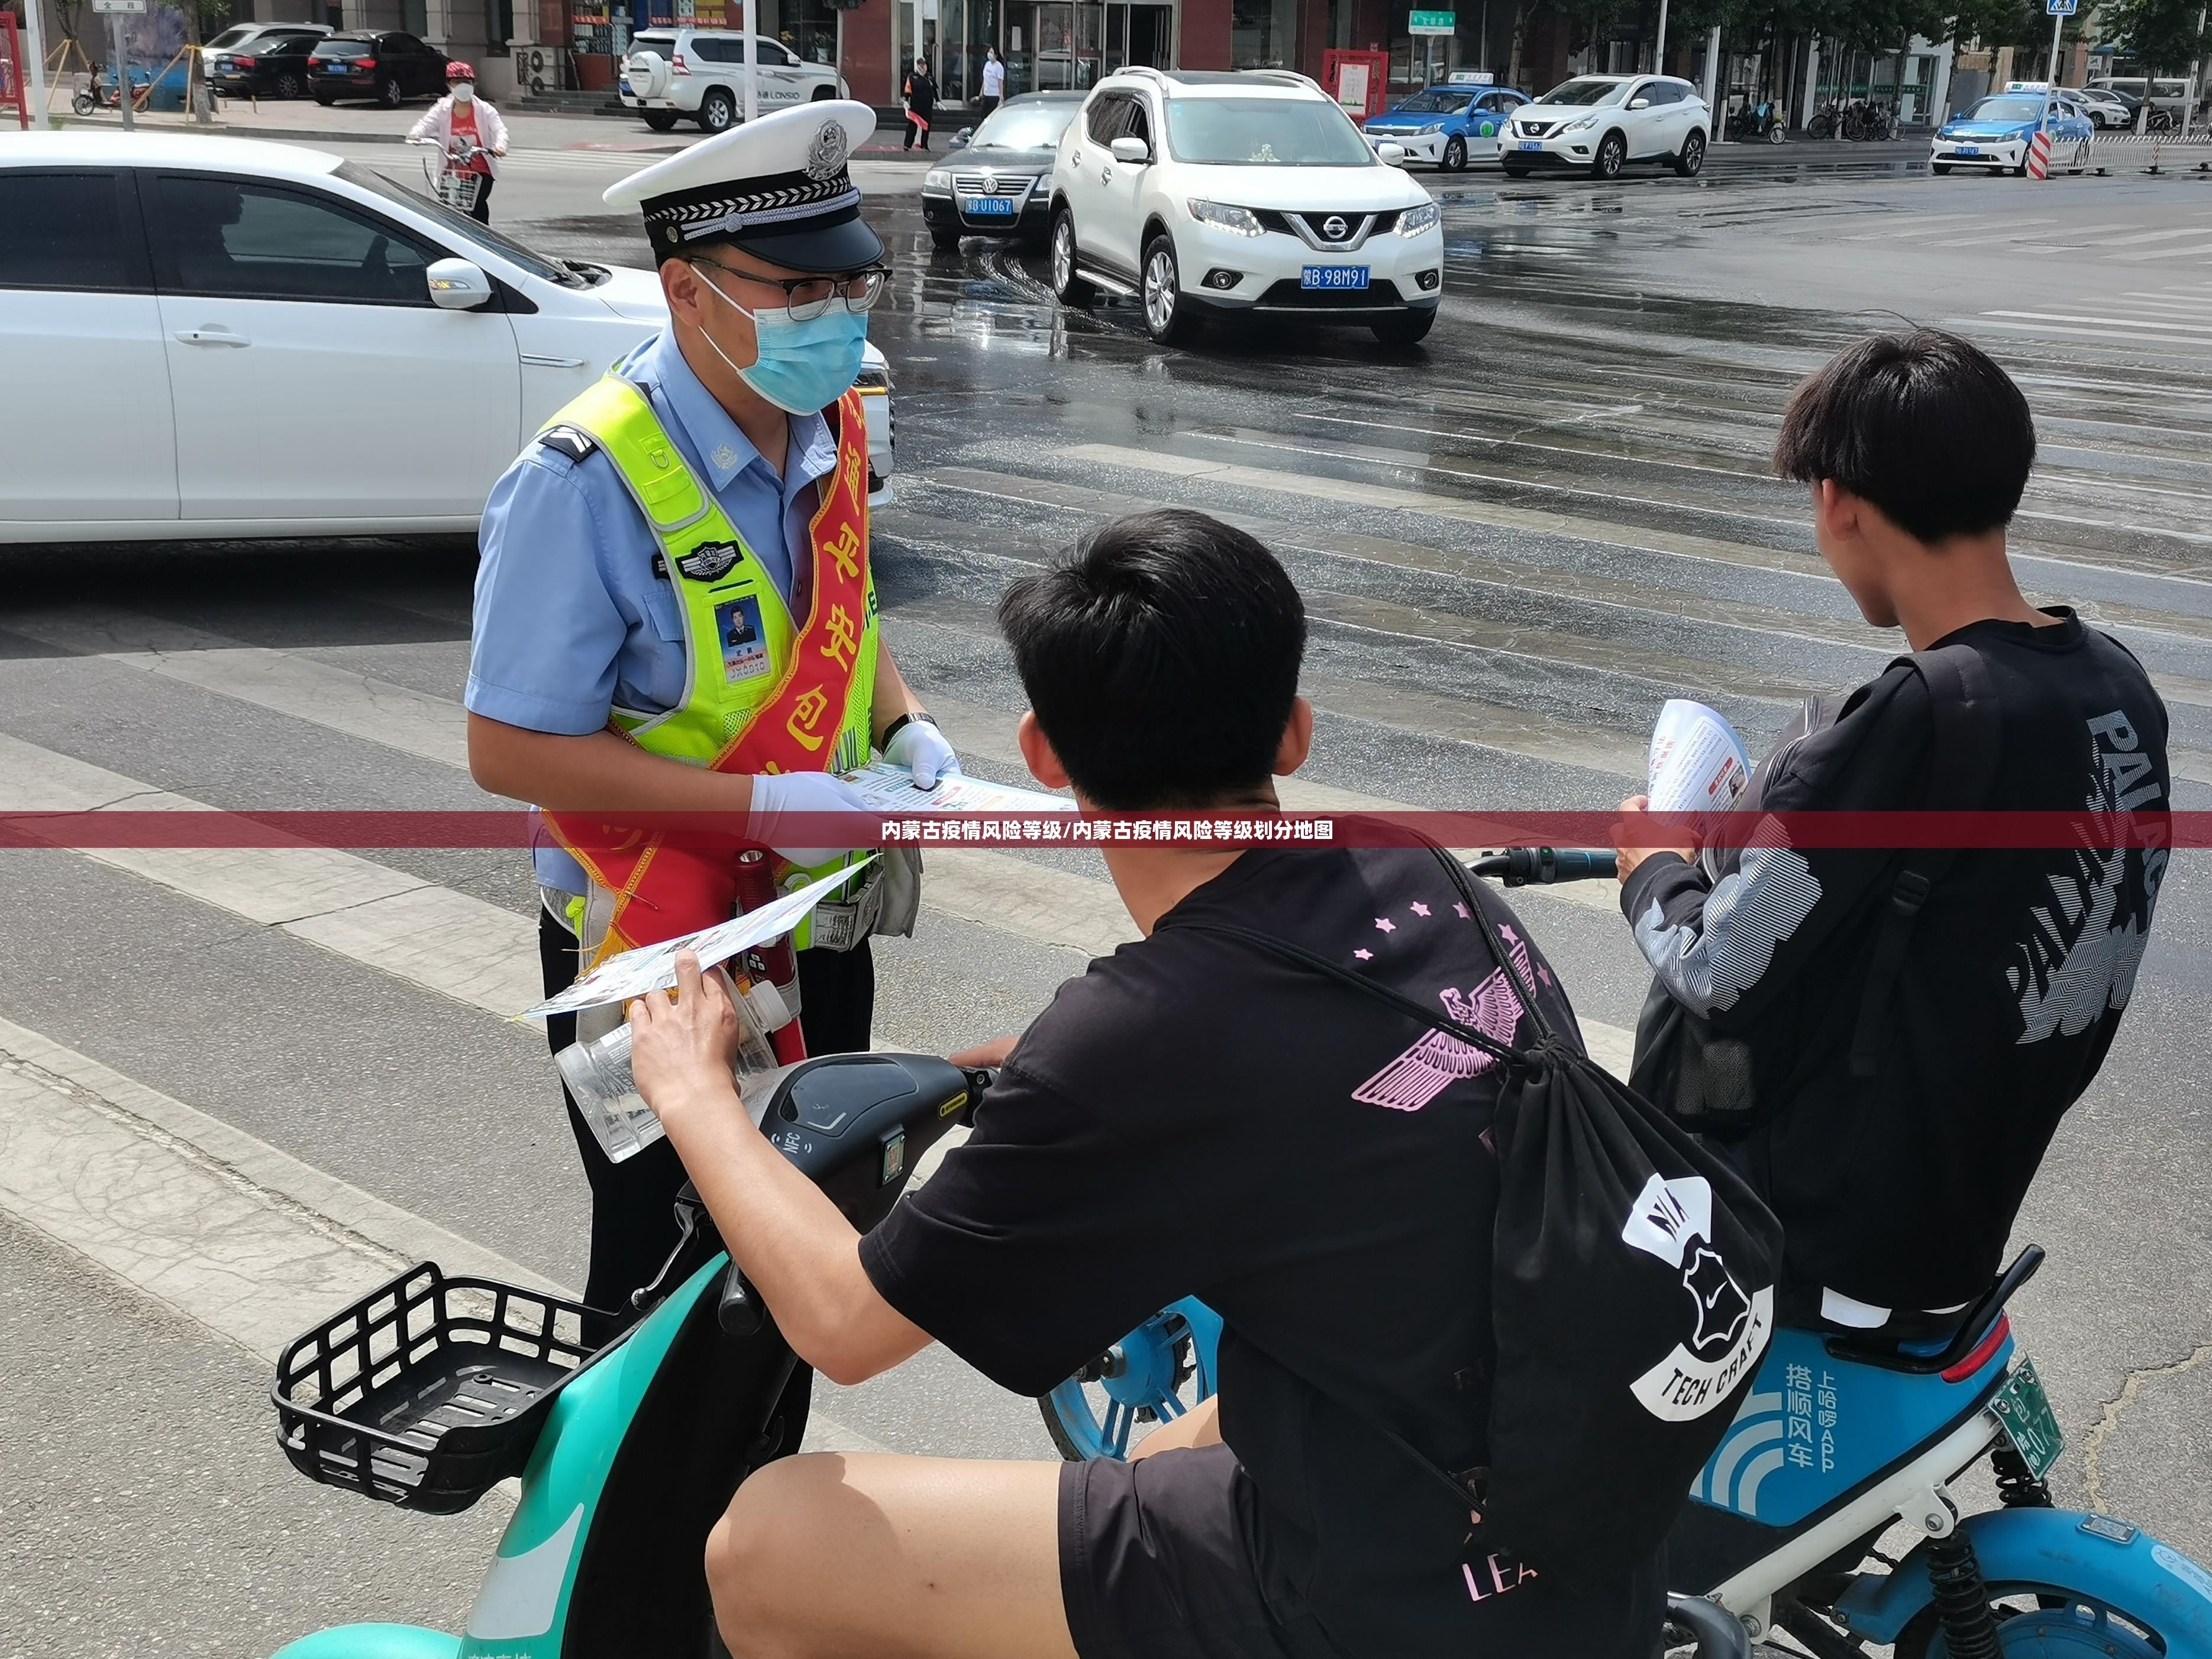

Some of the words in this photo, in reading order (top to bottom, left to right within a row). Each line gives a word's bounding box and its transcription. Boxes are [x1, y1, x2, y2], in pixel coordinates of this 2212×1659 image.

[2085, 709, 2168, 930] PALAC
[782, 1132, 801, 1154] NFC
[1661, 1367, 1713, 1406] TECH
[1716, 1312, 1762, 1395] CRAFT
[1785, 1363, 1814, 1468] 搭顺风车
[1817, 1370, 1838, 1474] 上哈啰APP
